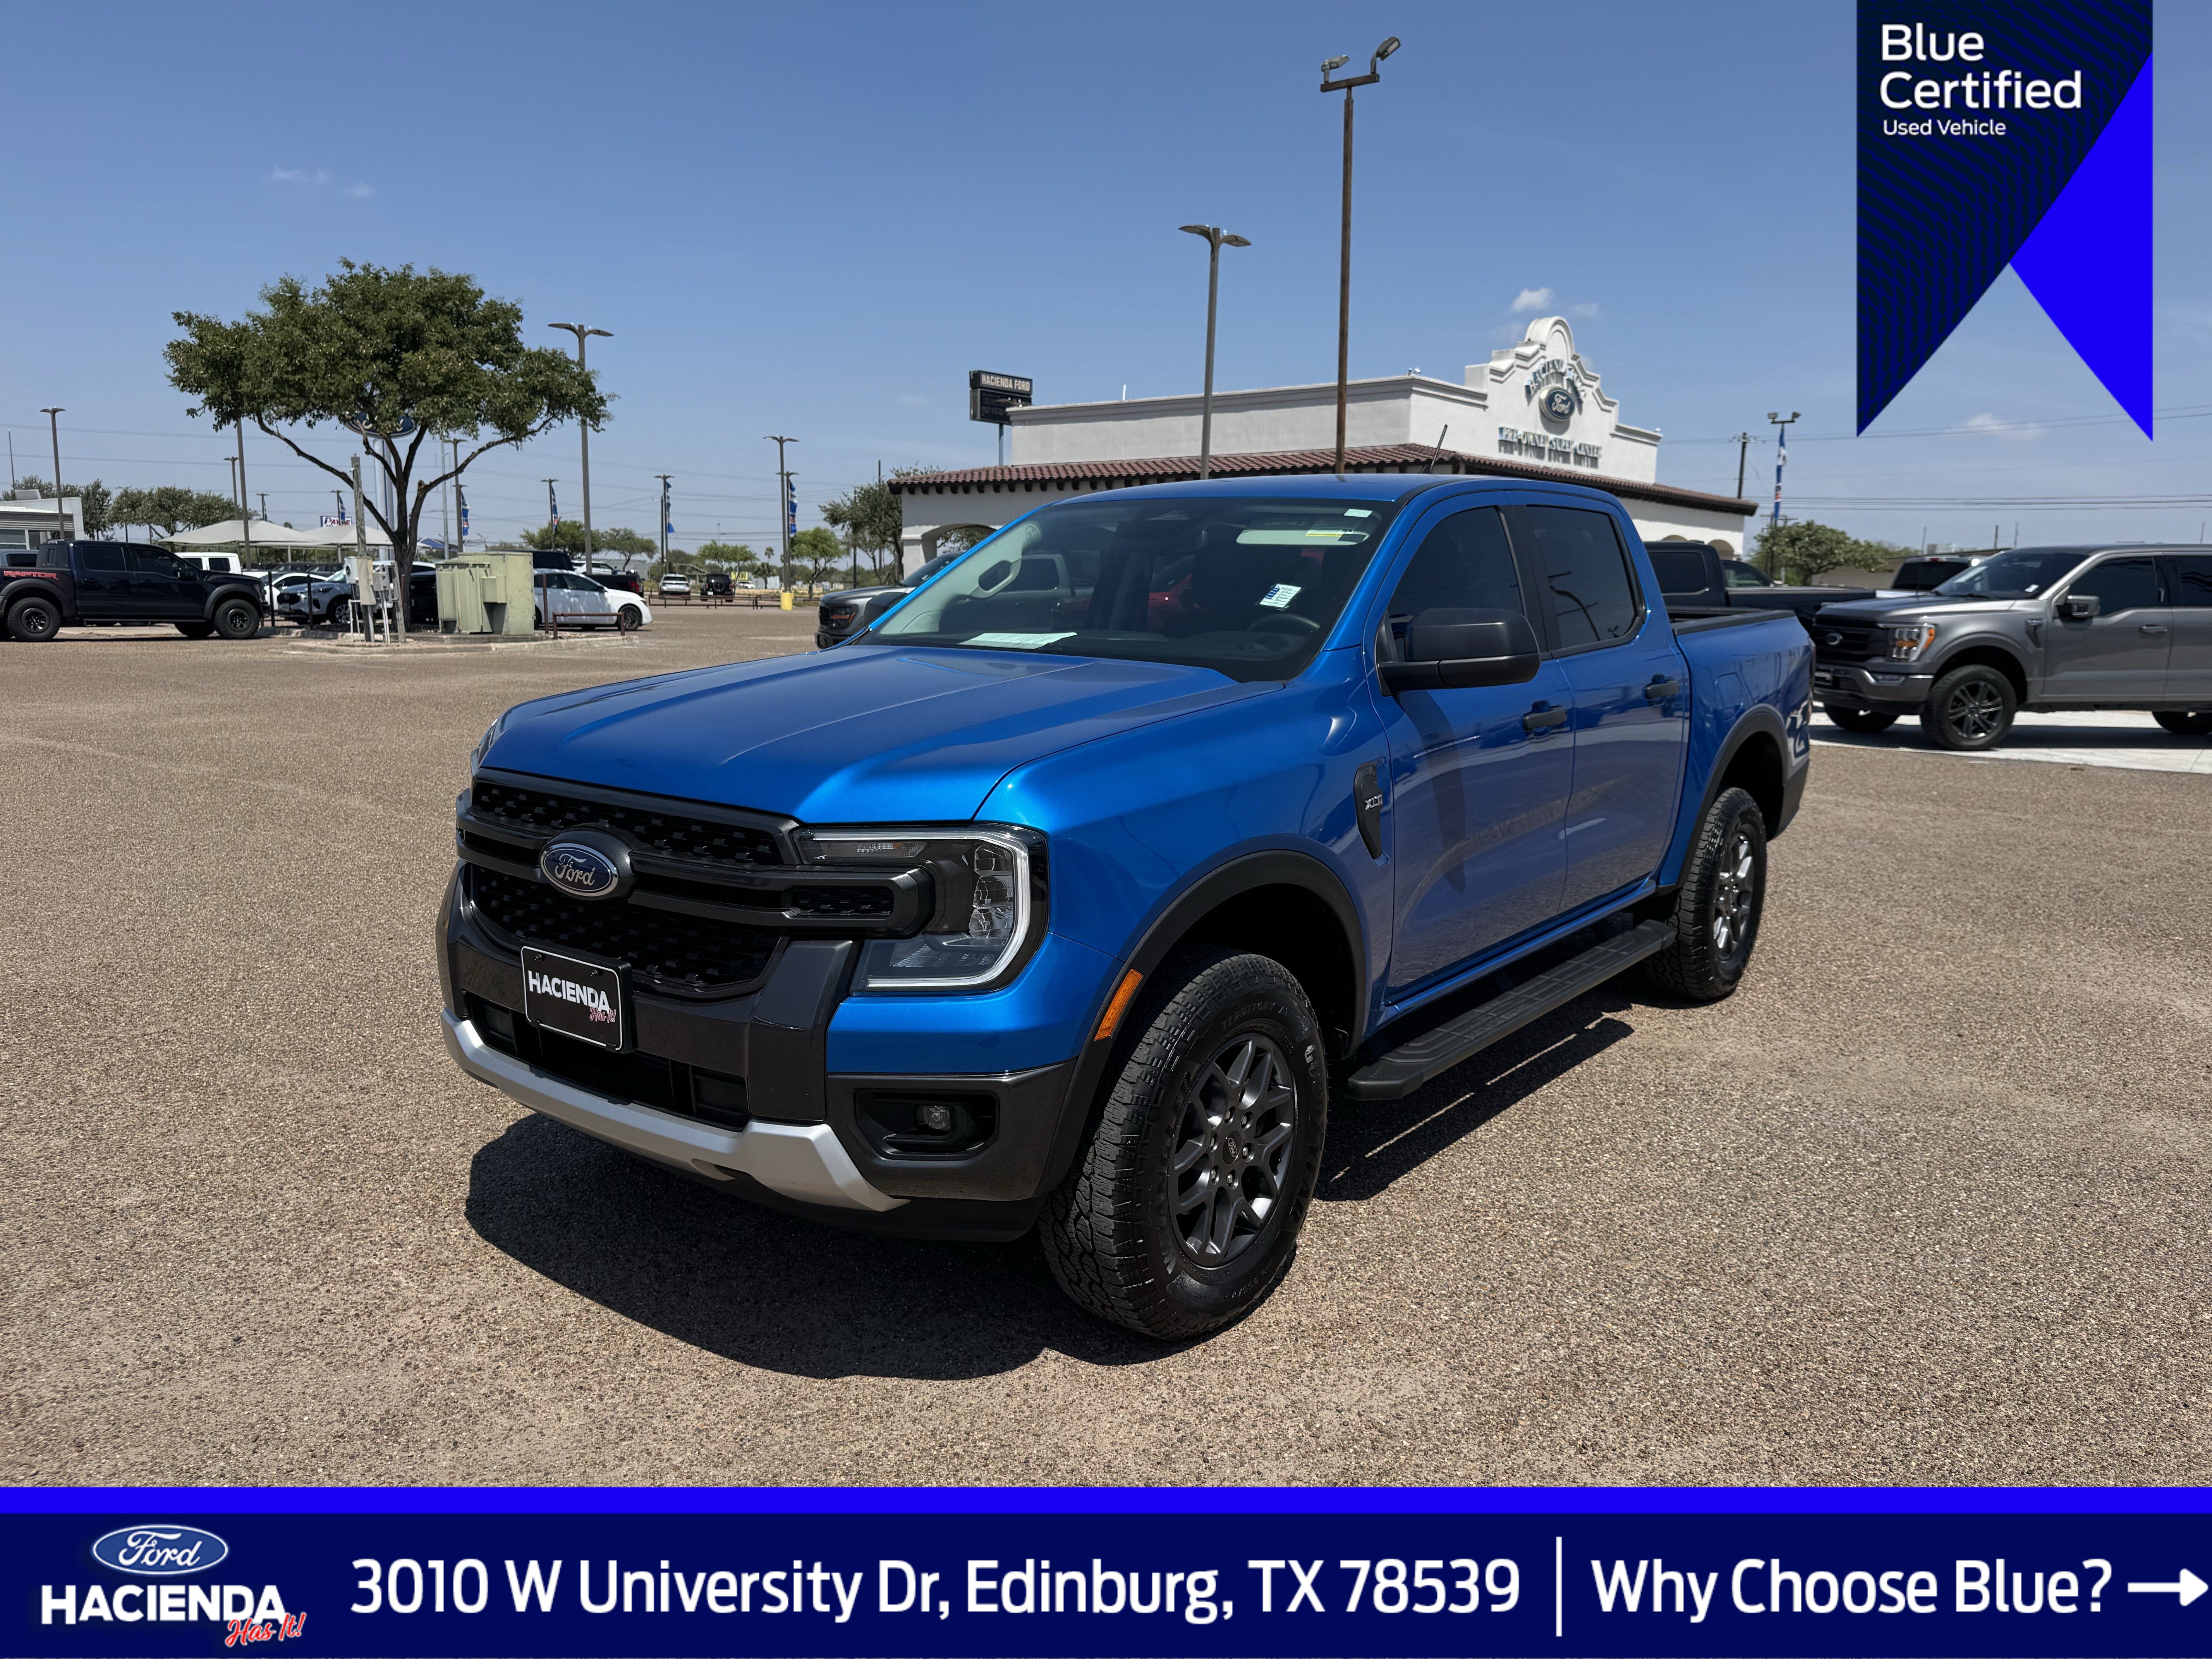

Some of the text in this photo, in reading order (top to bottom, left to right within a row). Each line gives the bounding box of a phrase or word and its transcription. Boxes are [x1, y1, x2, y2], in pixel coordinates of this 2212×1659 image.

[981, 374, 1030, 392] HACIENDA FORD
[1551, 393, 1571, 414] Ford
[3, 571, 59, 580] RAPTOR
[1364, 794, 1383, 810] XLT
[555, 853, 596, 886] Ford
[527, 970, 610, 1012] HACIENDA
[589, 1007, 607, 1022] Has
